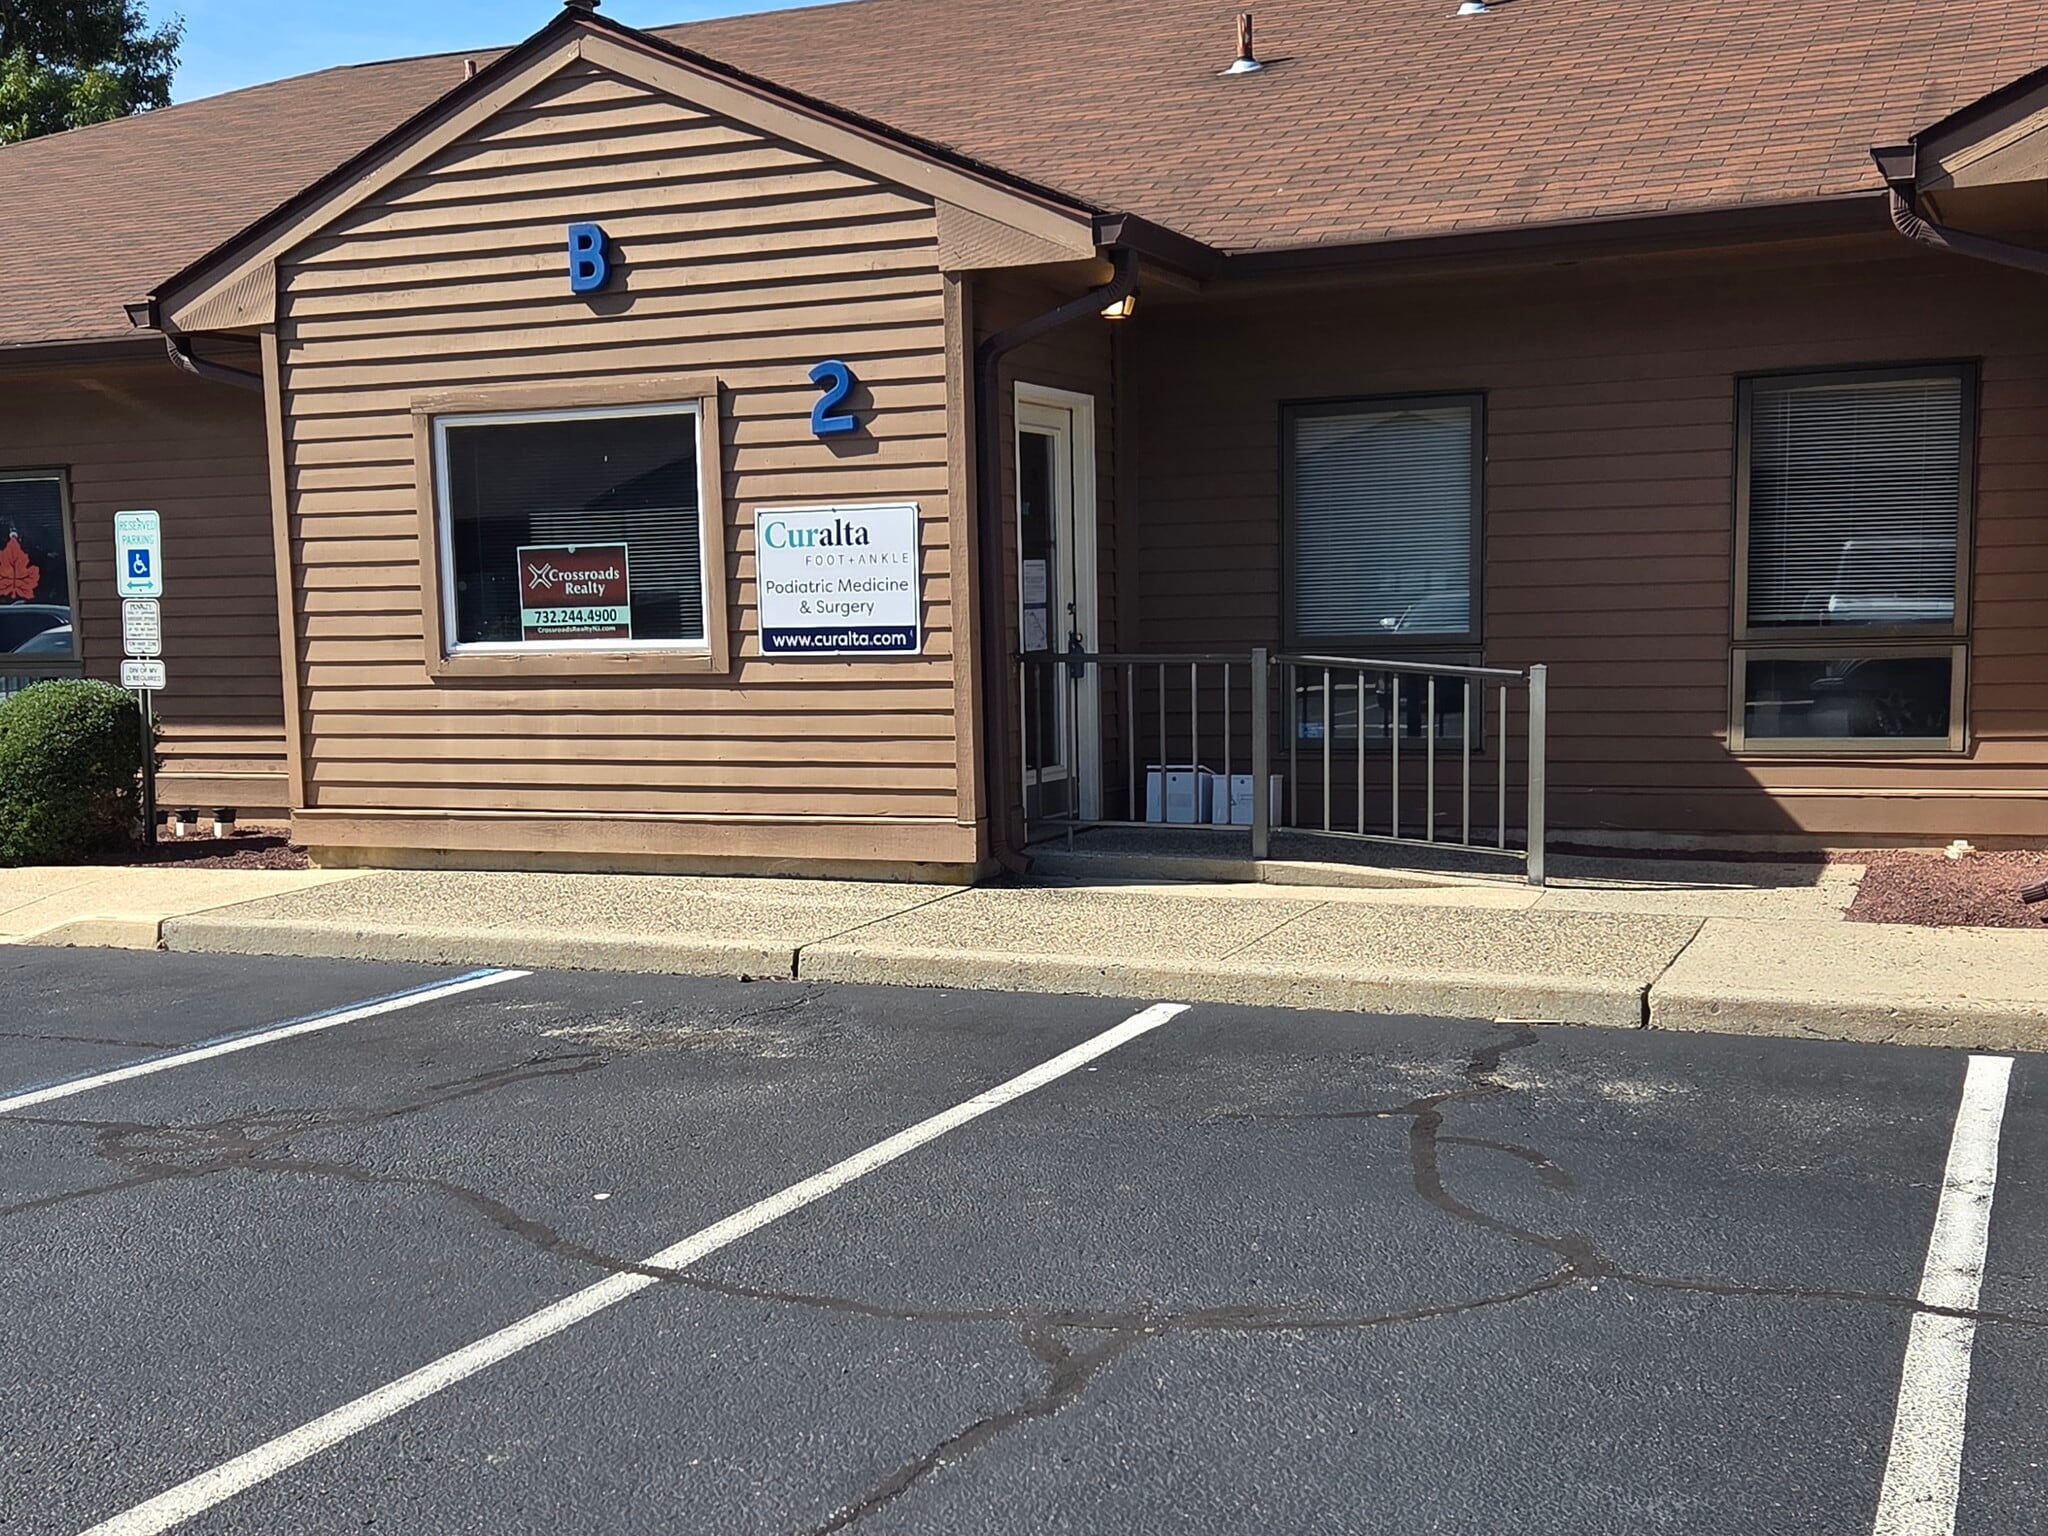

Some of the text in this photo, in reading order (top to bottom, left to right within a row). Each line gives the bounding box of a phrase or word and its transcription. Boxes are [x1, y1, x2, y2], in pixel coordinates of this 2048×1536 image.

[568, 222, 609, 294] B
[808, 360, 858, 436] 2
[119, 520, 156, 531] RESERVED
[764, 518, 870, 549] Curalta
[122, 534, 155, 545] PARKING
[549, 567, 620, 581] Crossroads
[565, 582, 605, 597] Realty
[767, 577, 909, 594] Podiatric Medicine
[535, 609, 617, 623] 732.244.4900
[799, 600, 875, 617] & Surgery
[772, 630, 906, 647] www.curalta.com
